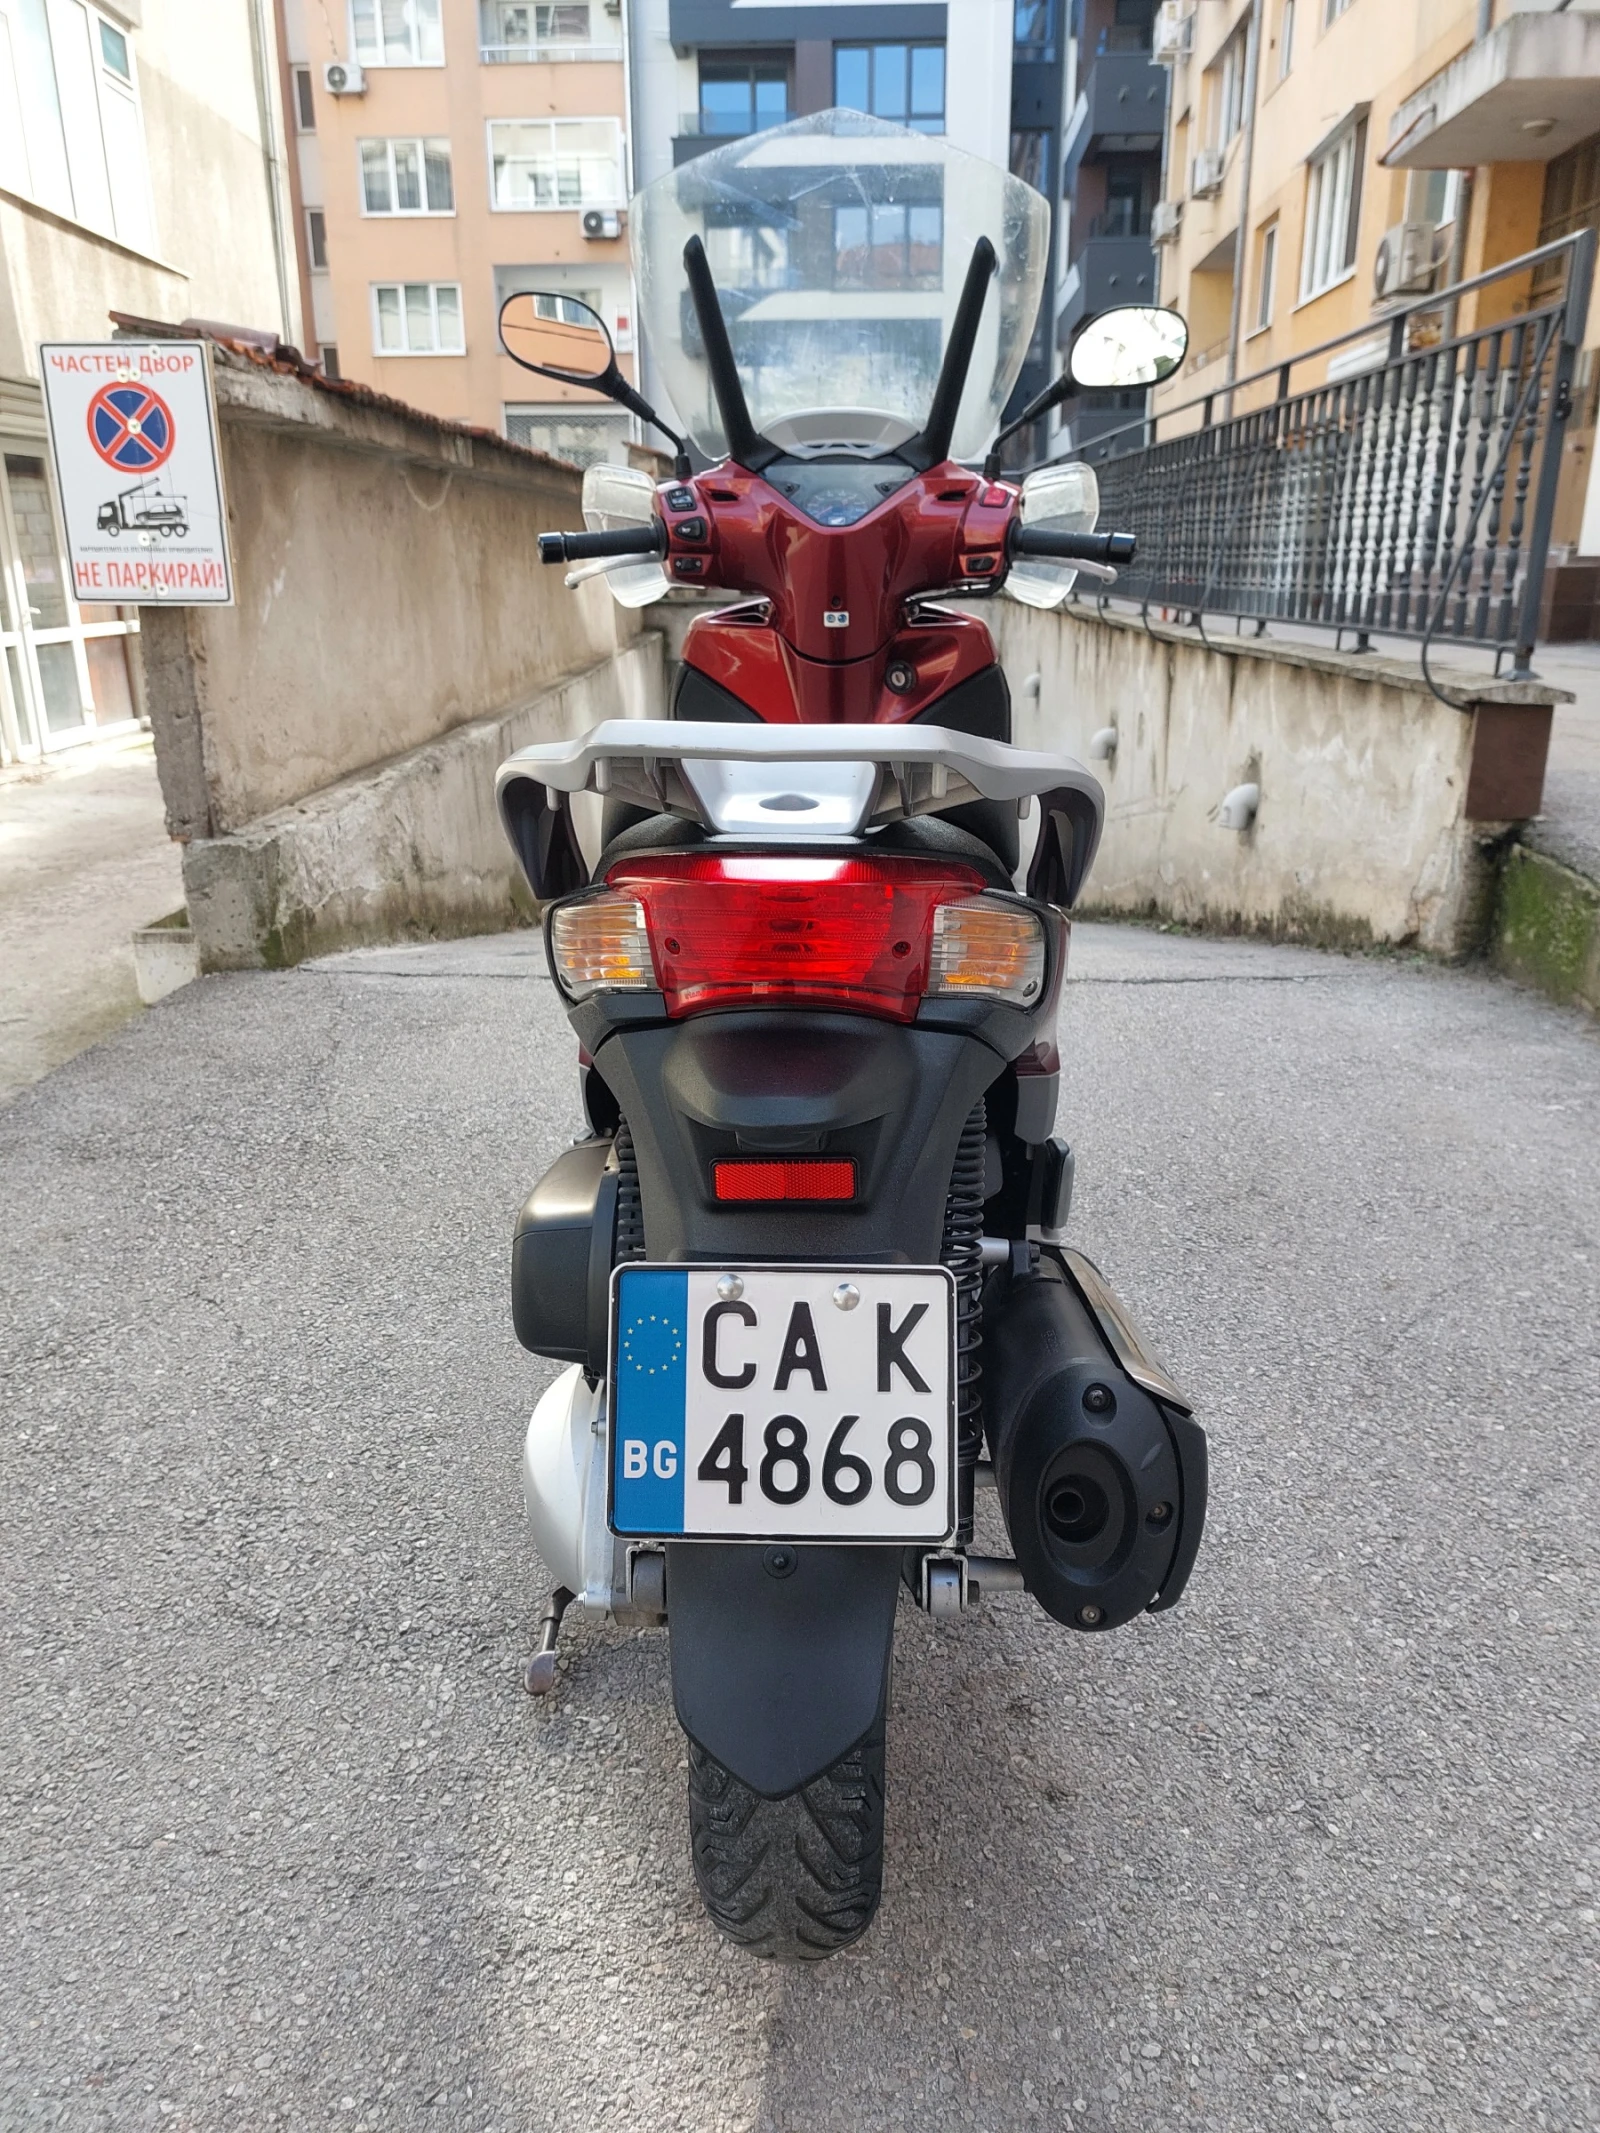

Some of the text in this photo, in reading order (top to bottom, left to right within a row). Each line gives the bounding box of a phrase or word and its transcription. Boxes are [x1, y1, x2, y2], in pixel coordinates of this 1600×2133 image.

[51, 355, 194, 375] ЧАСТЕН ДВОР
[76, 559, 224, 588] НЕ ПАРКИРАЙ!
[623, 1440, 677, 1479] BG
[697, 1413, 936, 1506] 4868
